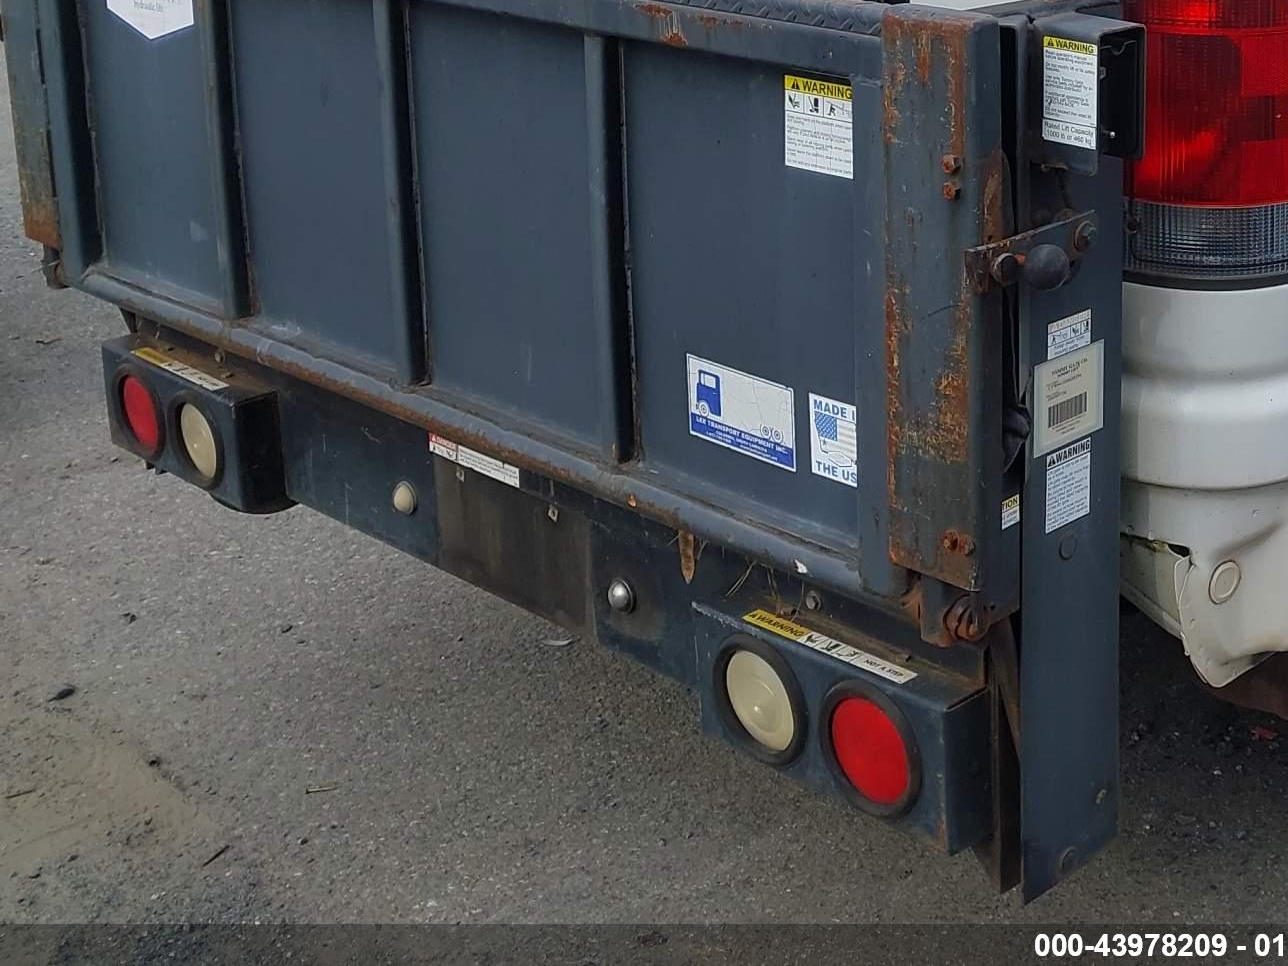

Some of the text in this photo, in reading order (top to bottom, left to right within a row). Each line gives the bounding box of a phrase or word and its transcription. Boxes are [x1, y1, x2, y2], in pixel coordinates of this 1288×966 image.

[1055, 39, 1094, 53] WARNING
[802, 80, 853, 99] WARNING
[1045, 121, 1094, 138] Rated Lift Capacity
[813, 398, 847, 418] MADE
[696, 416, 706, 425] LEE
[707, 420, 741, 436] TRANSPORT
[741, 432, 774, 450] EQUIPMENT
[1055, 439, 1090, 464] WARNING
[816, 460, 838, 477] THE
[757, 614, 805, 637] WARNING
[864, 658, 879, 668] NOT
[887, 668, 904, 678] STEP
